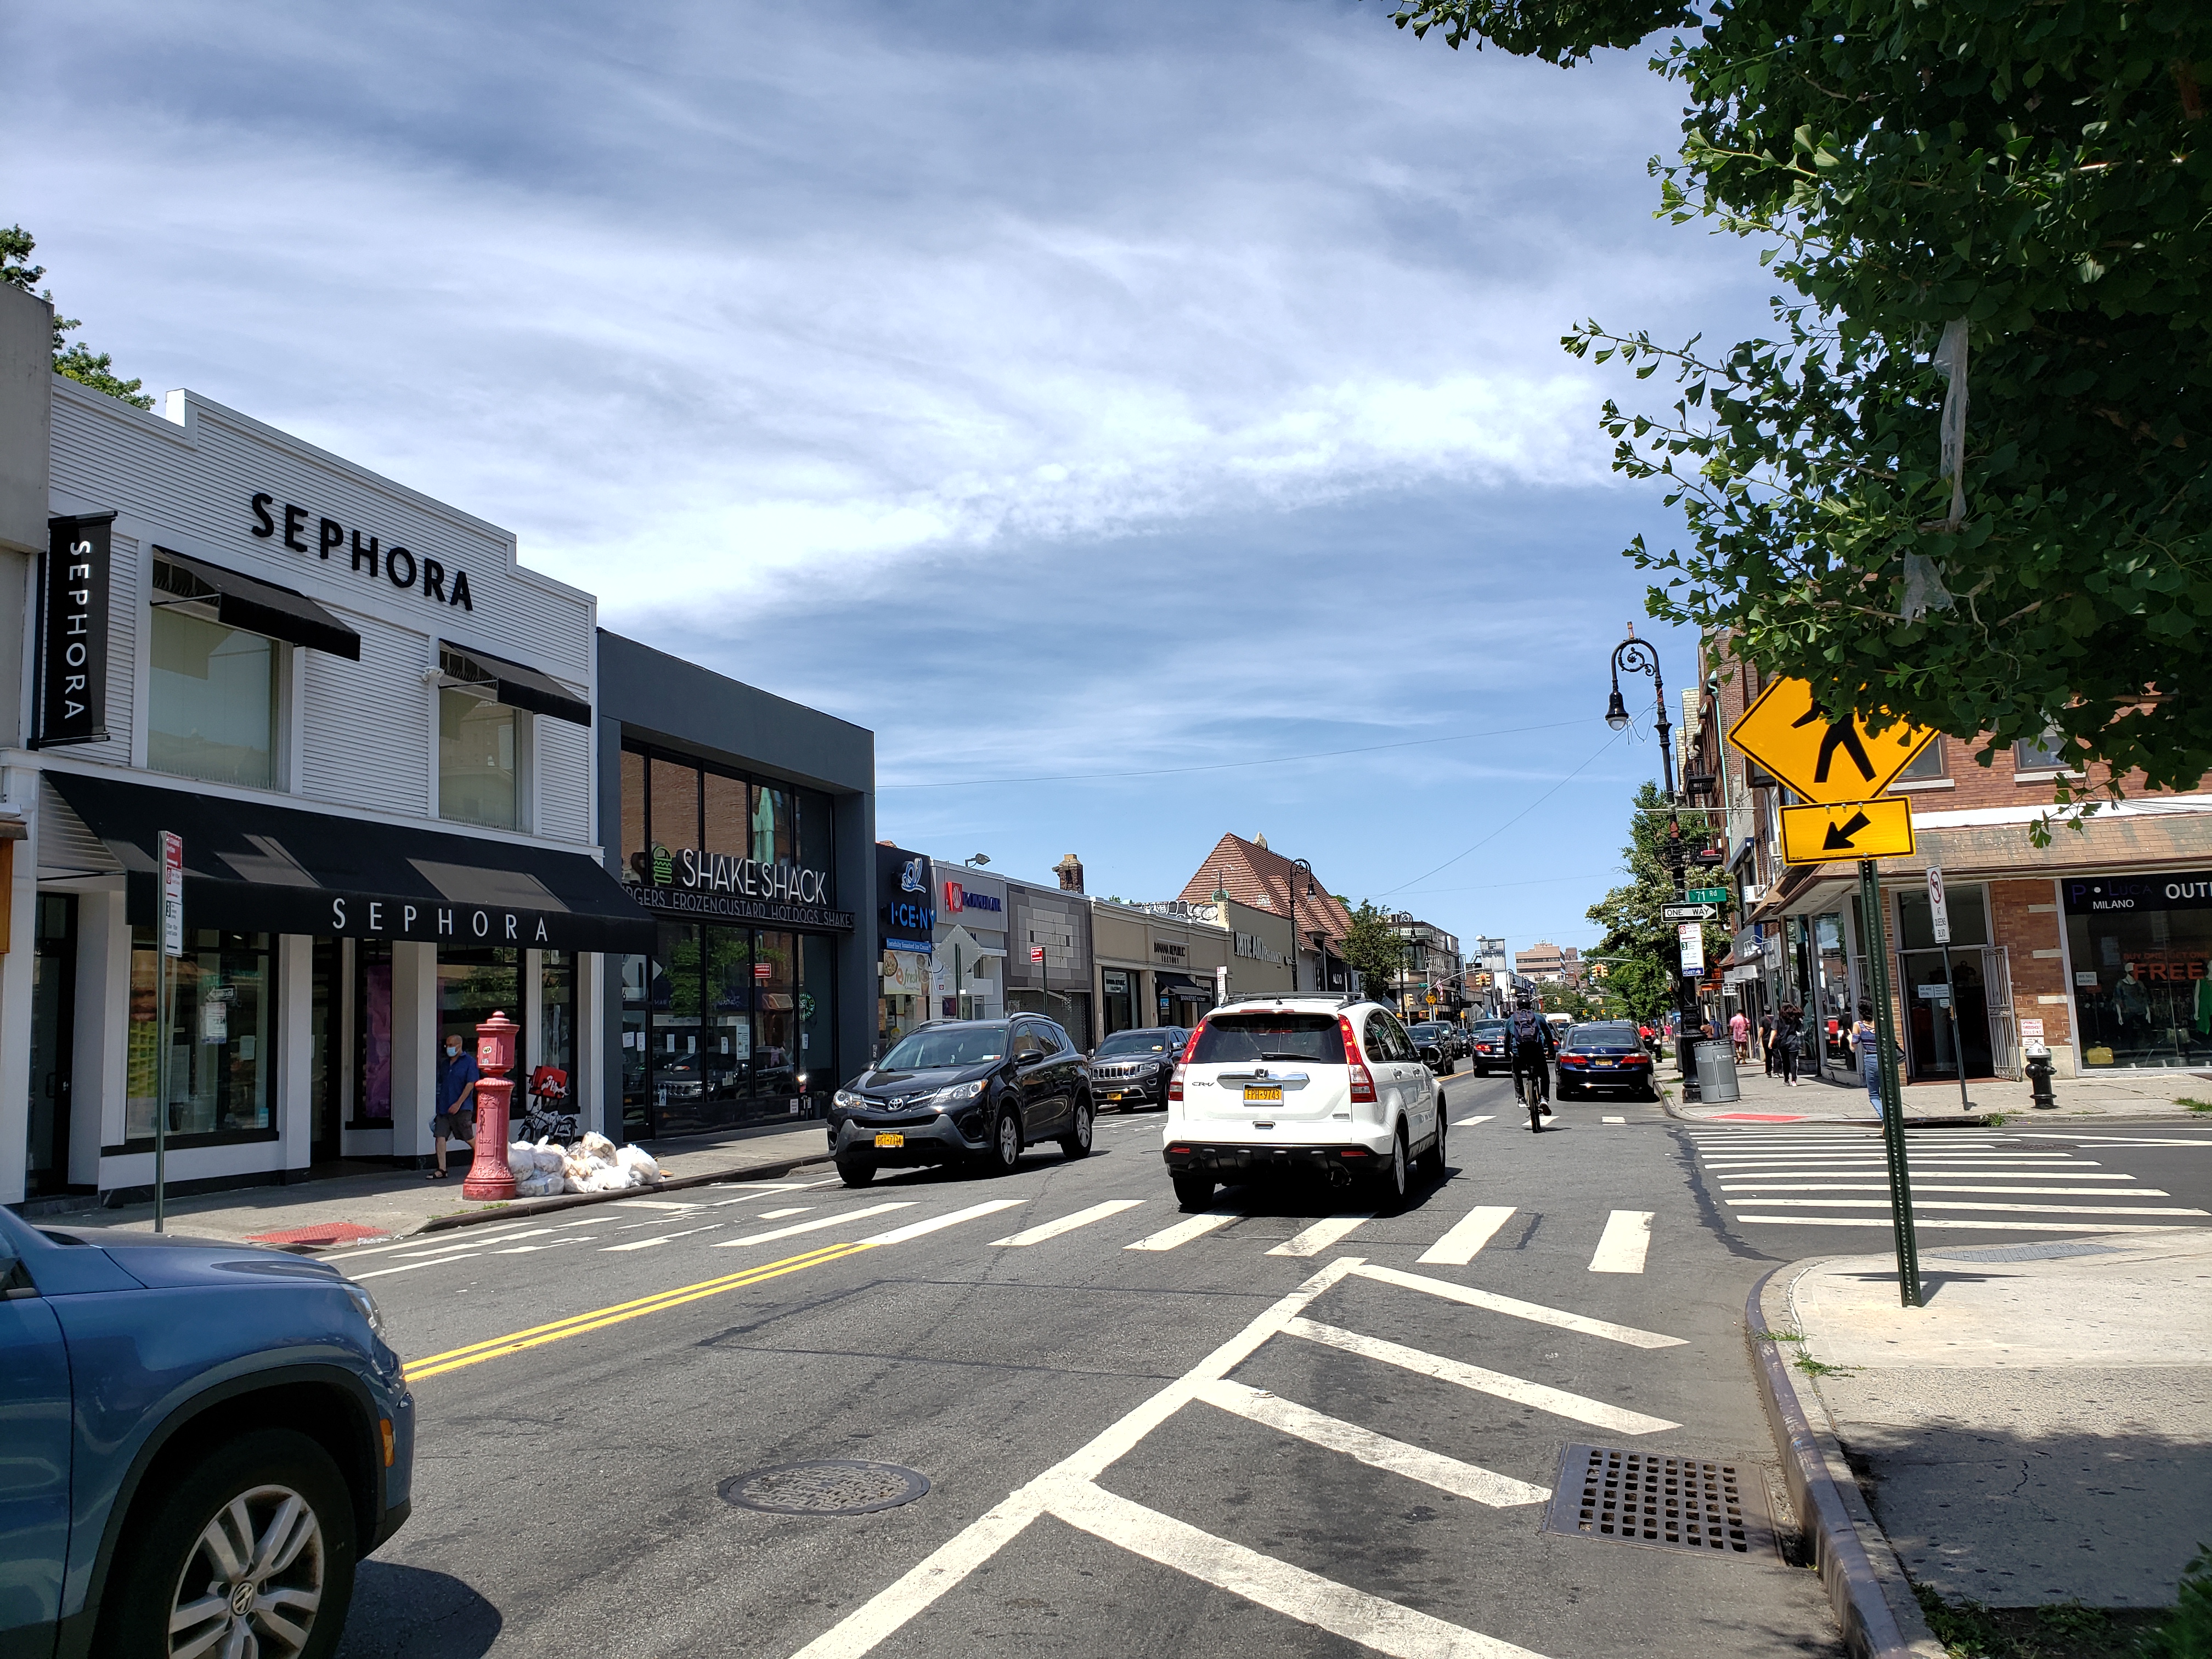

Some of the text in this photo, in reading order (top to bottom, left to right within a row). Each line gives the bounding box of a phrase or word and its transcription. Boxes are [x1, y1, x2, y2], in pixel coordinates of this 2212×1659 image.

[251, 493, 473, 611] SEPHORA
[64, 540, 91, 720] SEPHORA
[682, 848, 827, 905] SHAKE SHACK
[1696, 891, 1706, 901] 71
[2166, 882, 2212, 899] OUT
[332, 898, 548, 941] SEPHORA
[623, 885, 854, 928] RGERS FROZEN CUSTARD HOT DOGS SHAKES
[2093, 899, 2134, 909] MILANO
[2133, 962, 2204, 981] FREE
